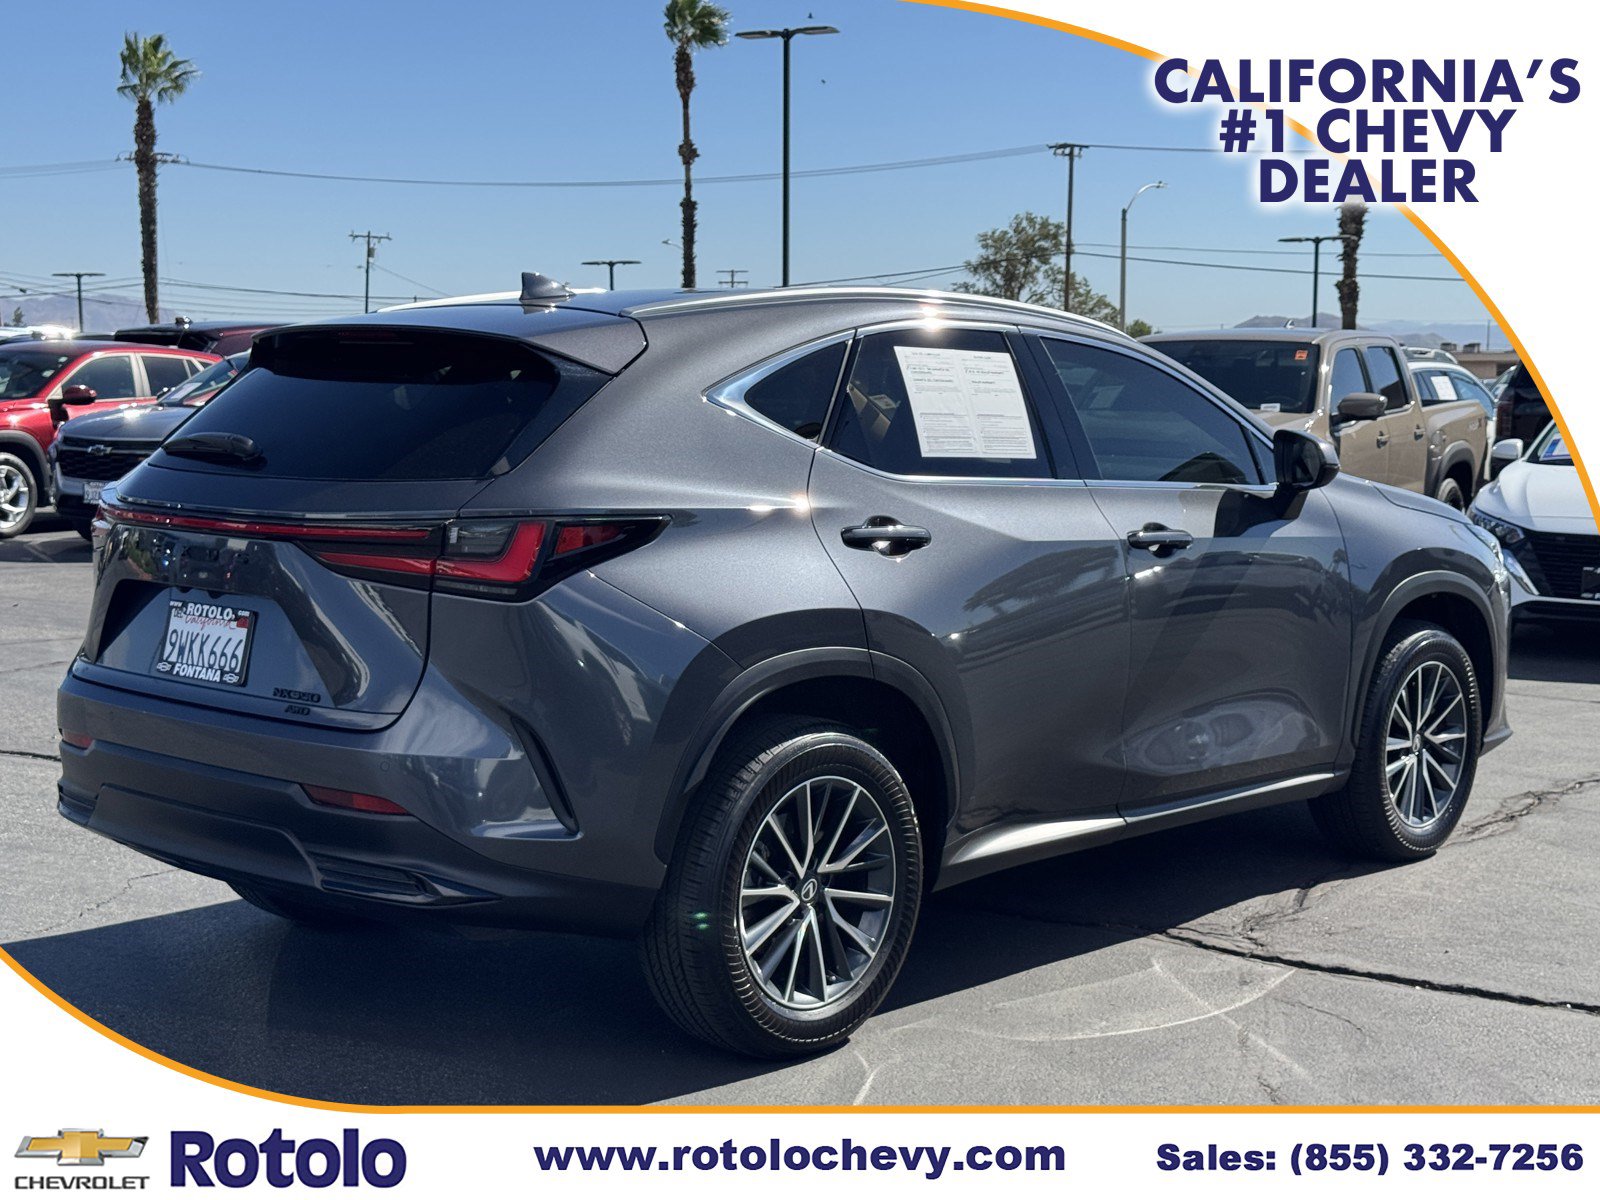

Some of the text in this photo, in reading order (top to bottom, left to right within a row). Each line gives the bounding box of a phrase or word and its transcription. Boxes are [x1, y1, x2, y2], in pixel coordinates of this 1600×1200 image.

[186, 602, 233, 620] ROTOLO
[165, 628, 243, 673] 9WKK666
[172, 663, 221, 682] FONTANA
